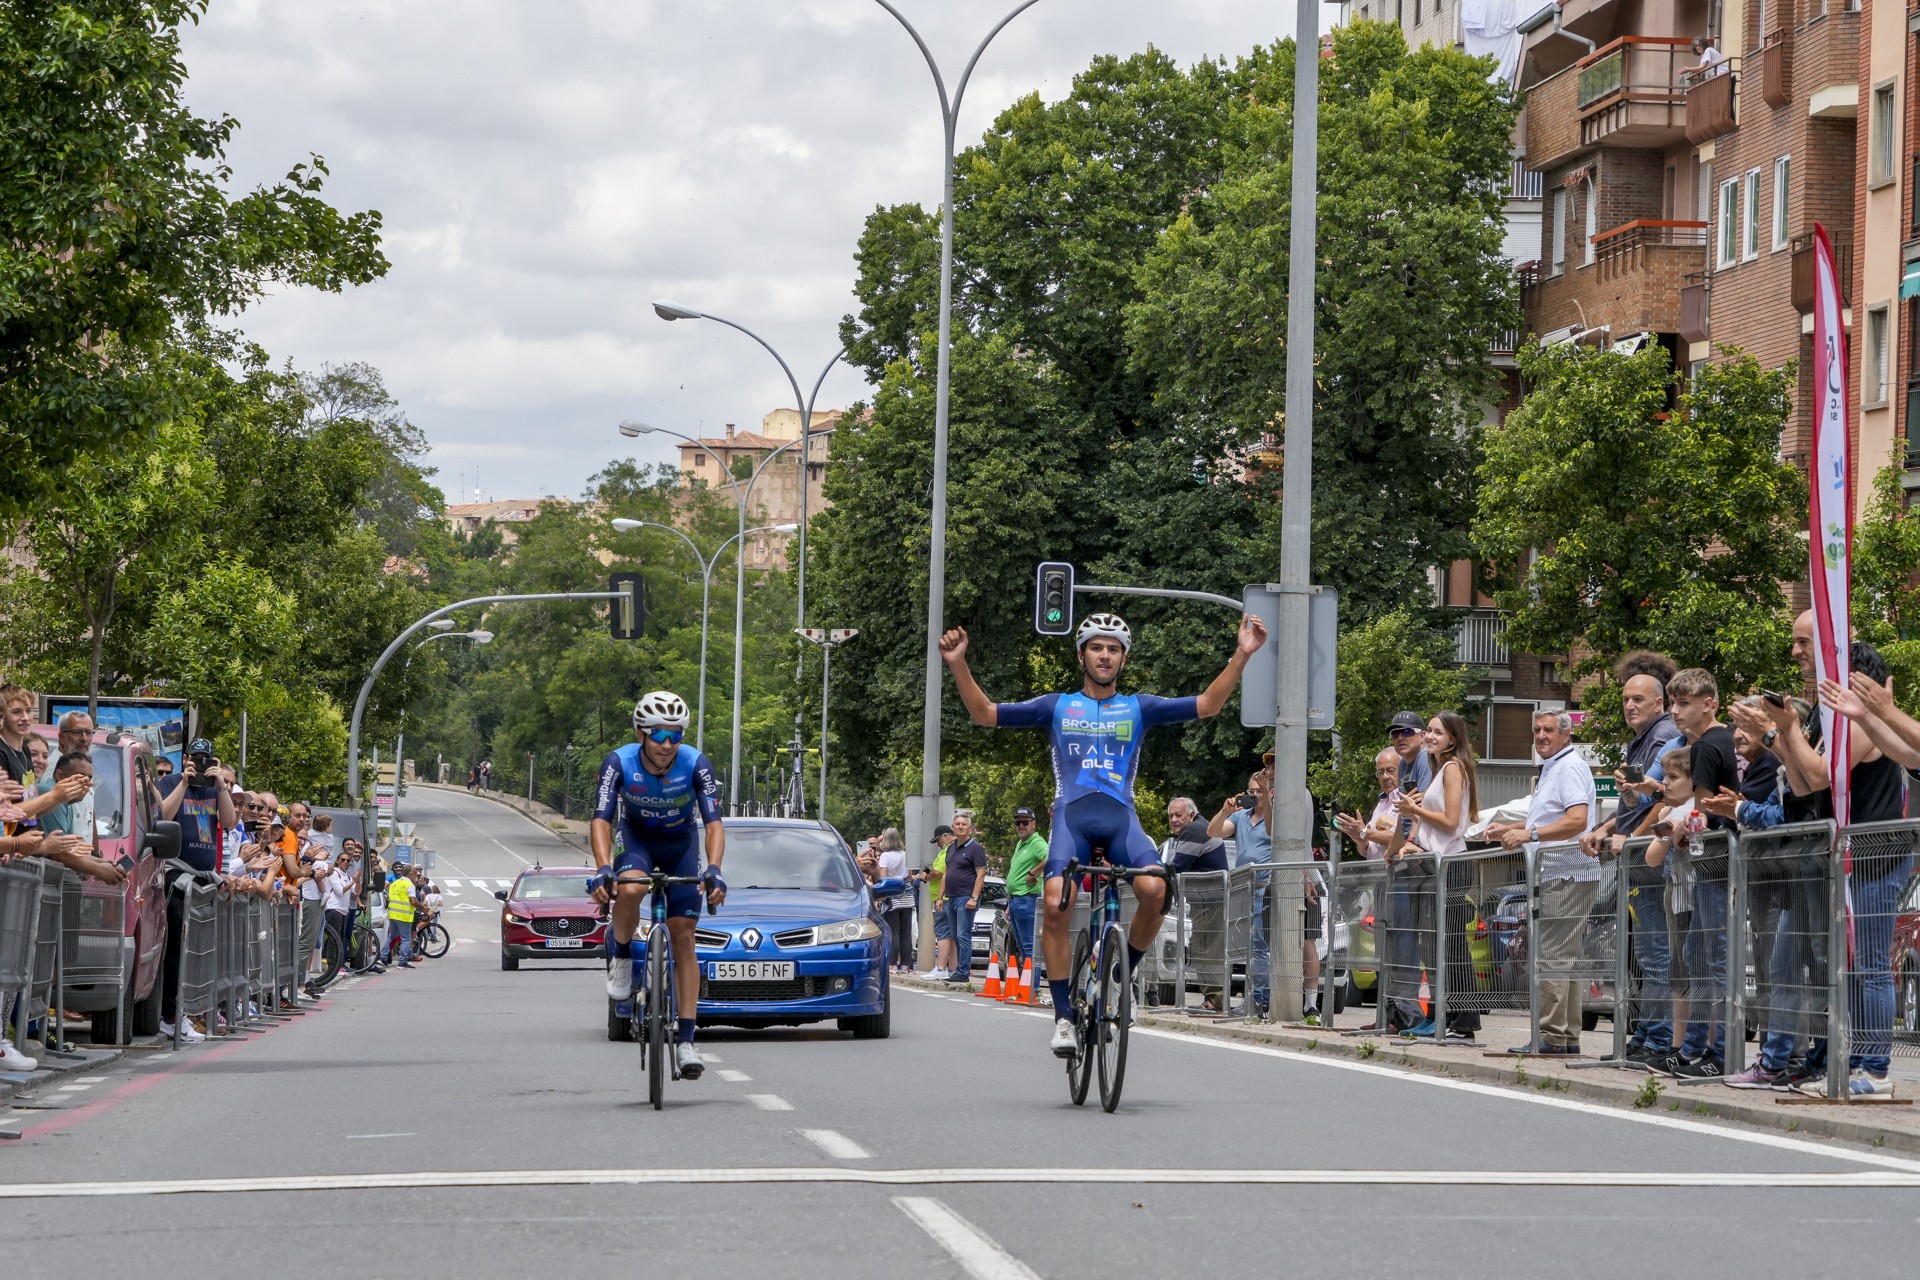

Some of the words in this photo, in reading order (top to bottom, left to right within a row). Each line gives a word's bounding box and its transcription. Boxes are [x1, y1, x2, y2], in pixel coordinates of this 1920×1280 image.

[1061, 718, 1115, 730] BROCAR
[718, 963, 757, 978] 5516
[762, 963, 791, 978] FNF
